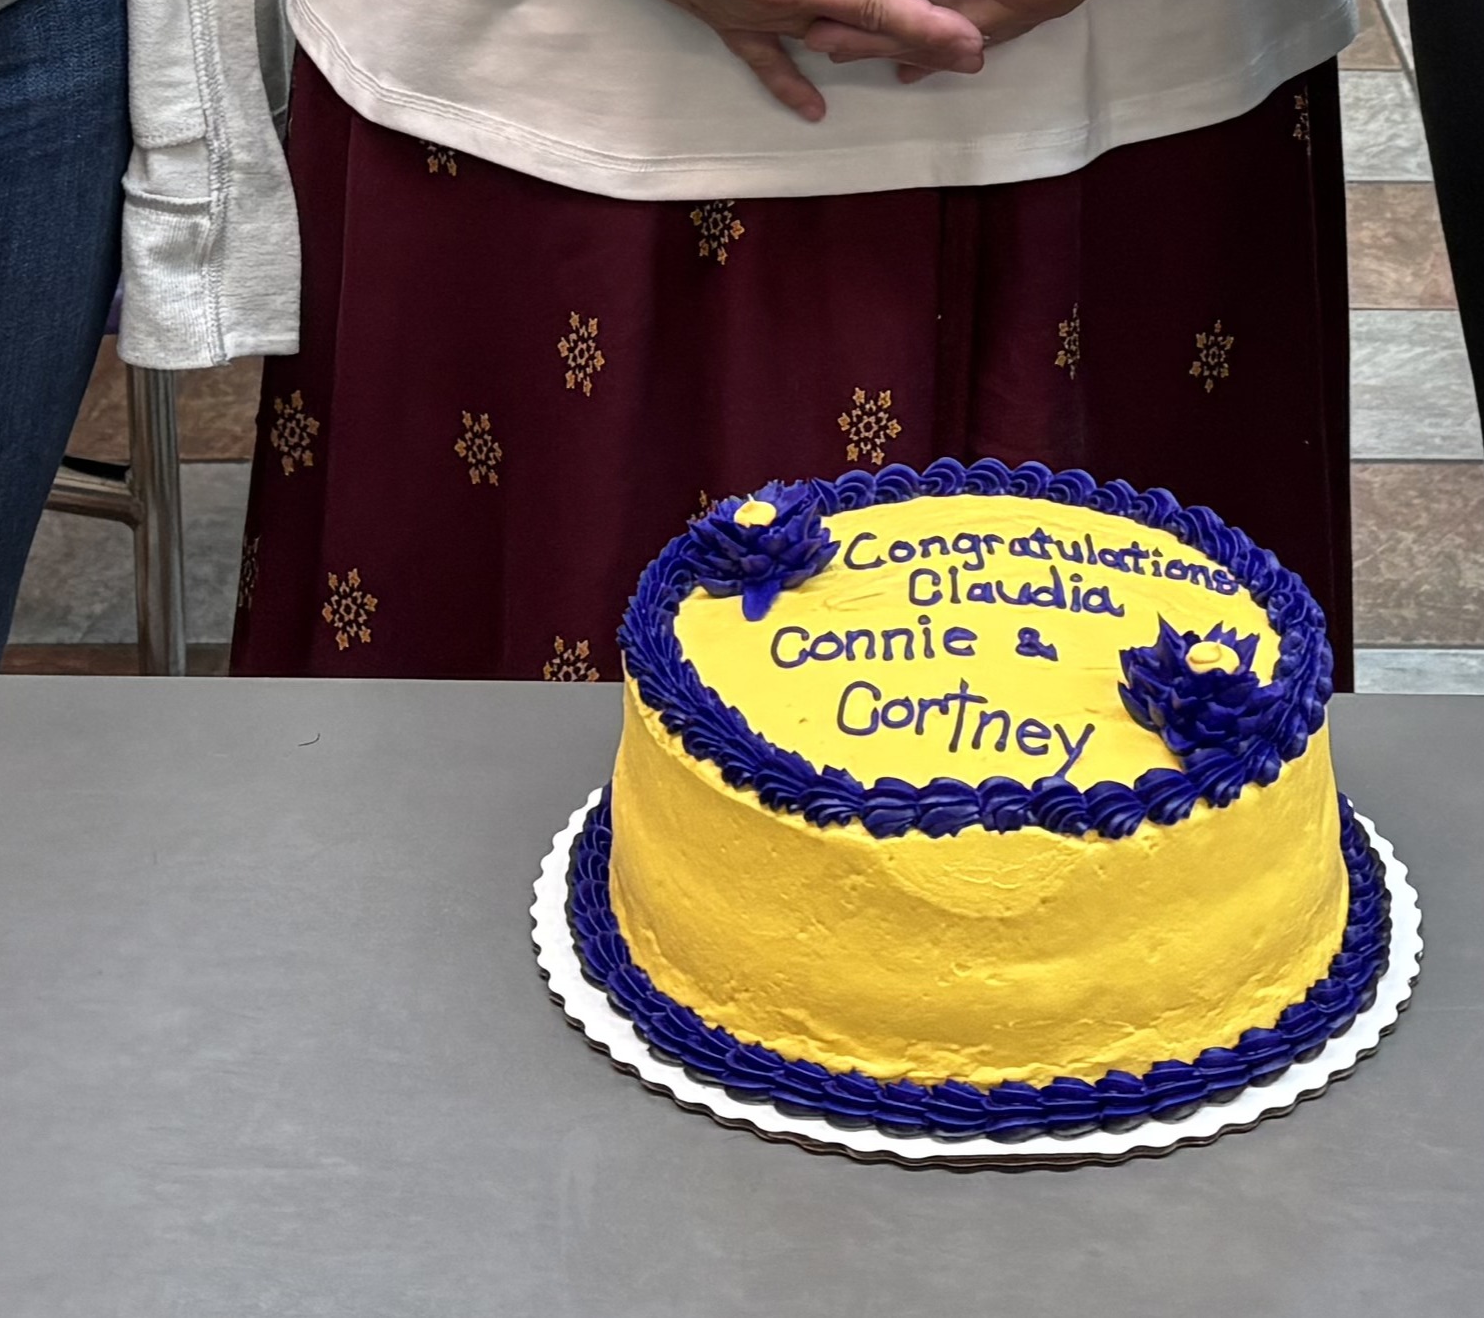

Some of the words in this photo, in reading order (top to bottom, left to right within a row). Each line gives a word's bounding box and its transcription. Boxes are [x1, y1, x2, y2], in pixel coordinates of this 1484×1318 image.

[842, 531, 1240, 596] Congratulations
[907, 567, 1125, 618] Claudia
[769, 614, 977, 670] Connie
[1013, 626, 1060, 664] &
[836, 677, 1097, 780] Cortney
